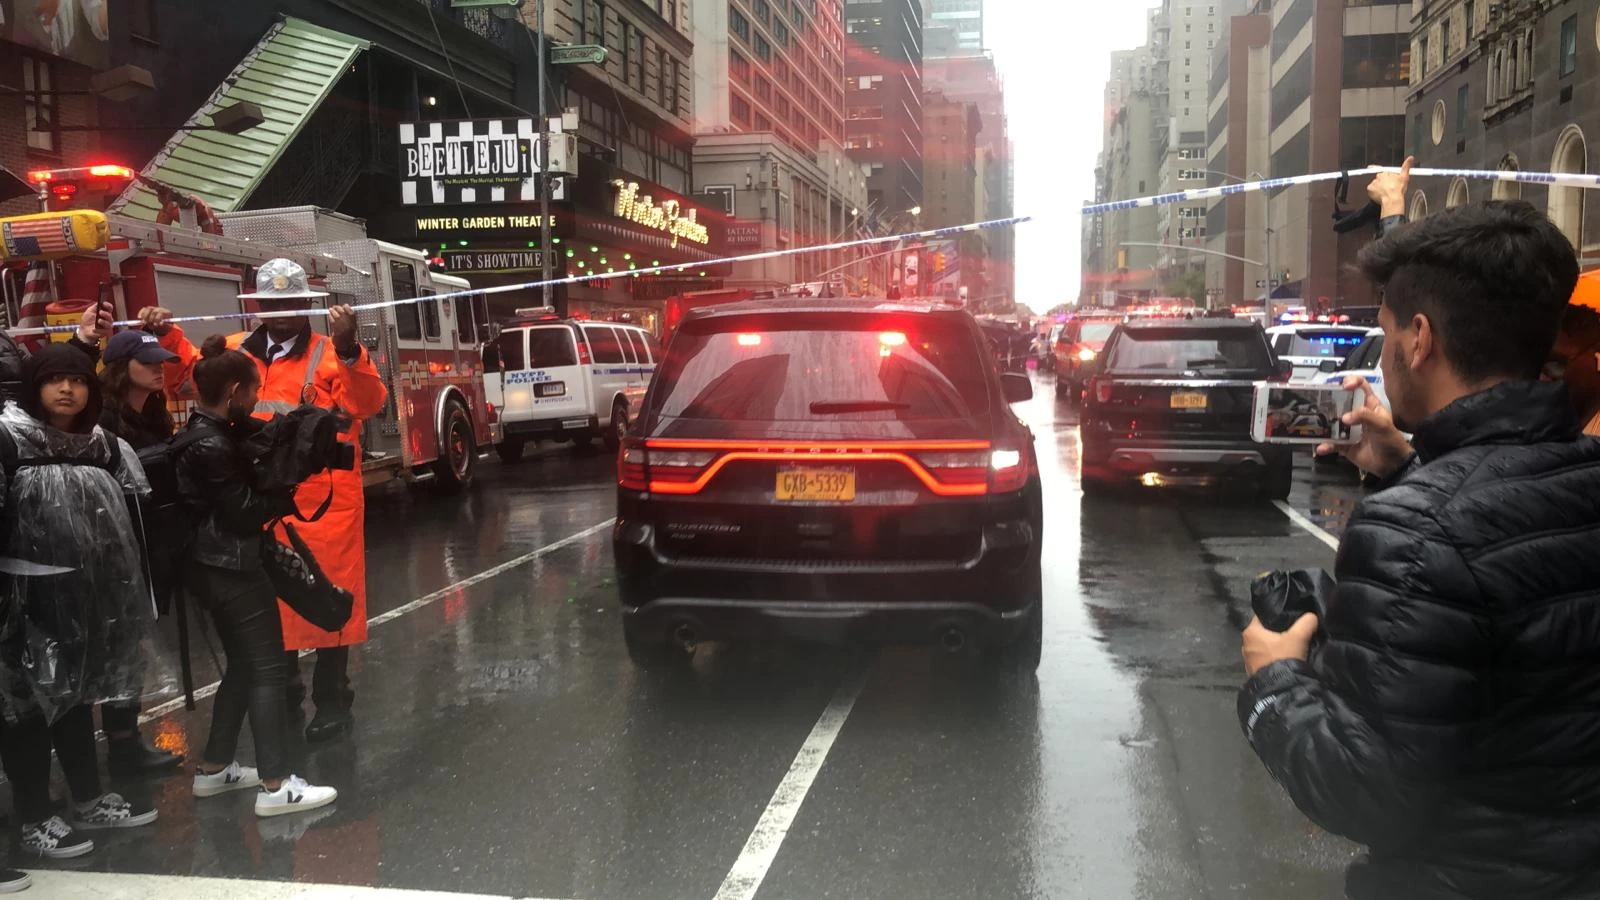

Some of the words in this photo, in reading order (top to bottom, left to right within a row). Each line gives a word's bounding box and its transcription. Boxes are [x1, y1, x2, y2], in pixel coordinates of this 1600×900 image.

[417, 218, 459, 230] WINTER
[462, 216, 505, 229] GARDEN
[508, 215, 556, 227] THEATE
[3, 222, 18, 255] KEEP
[451, 254, 473, 269] IT'S
[477, 252, 542, 269] SHOWTIME
[506, 375, 552, 384] POLICE
[511, 370, 546, 379] NYPD
